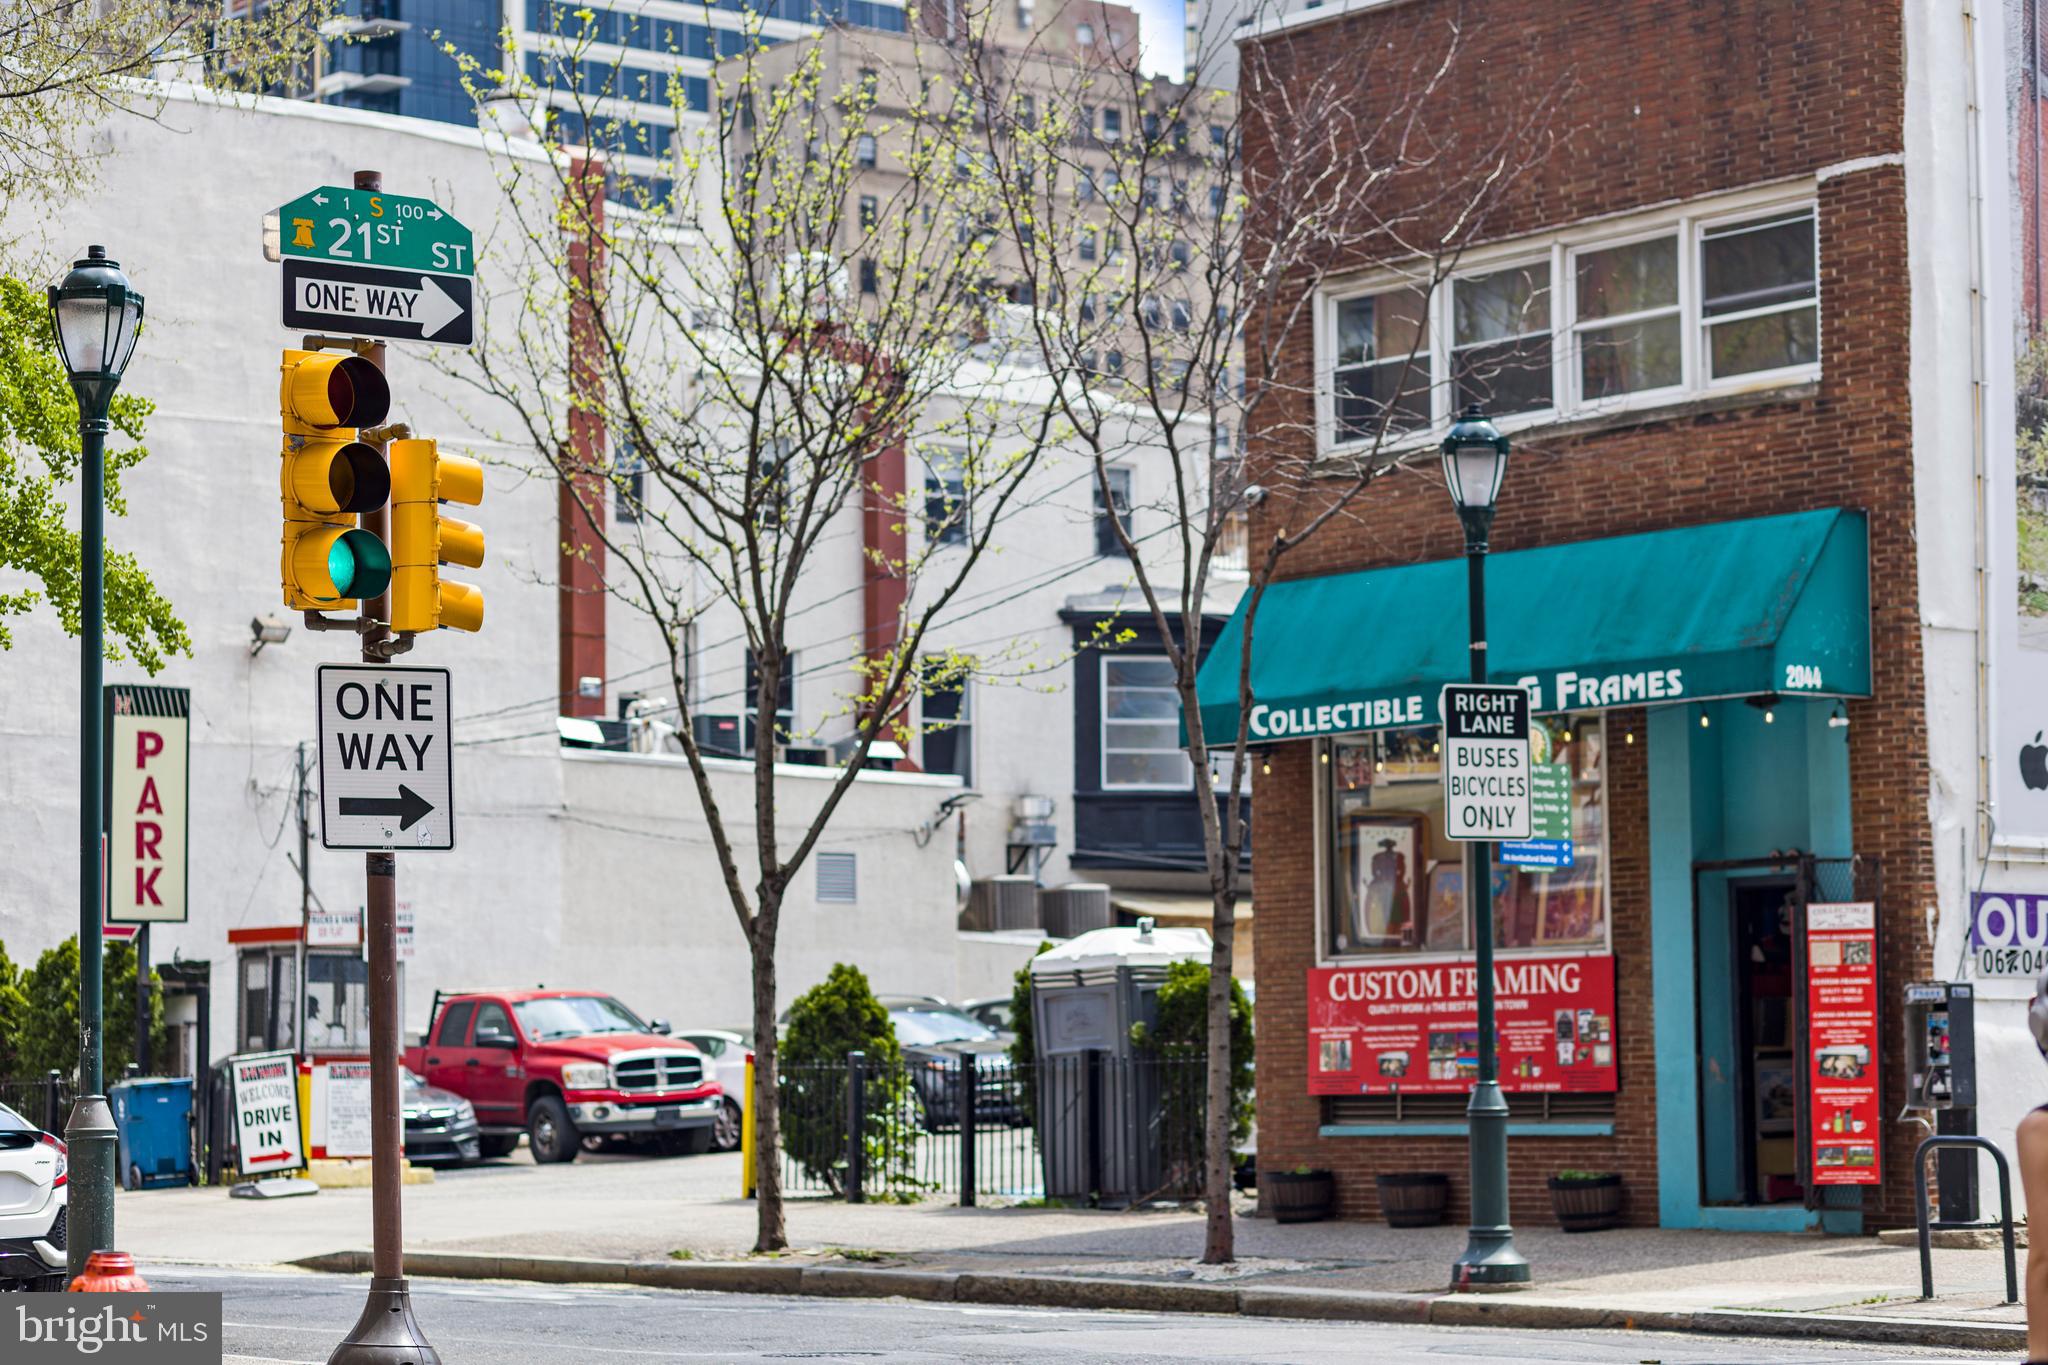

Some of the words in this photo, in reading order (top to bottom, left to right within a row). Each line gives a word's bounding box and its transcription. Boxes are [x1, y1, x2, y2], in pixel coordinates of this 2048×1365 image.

[344, 197, 350, 210] 1
[370, 197, 385, 217] S
[395, 204, 424, 220] 100
[328, 217, 404, 260] 21ST
[431, 242, 467, 270] ST
[305, 283, 356, 313] ONE
[366, 288, 418, 318] WAY
[1786, 664, 1822, 689] 2044
[336, 682, 434, 721] ONE
[1250, 695, 1423, 737] COLLECTIBLE
[1556, 668, 1684, 712] FRAMES
[1455, 693, 1519, 713] RIGHT
[1460, 715, 1515, 734] LANE
[337, 733, 434, 771] WAY
[1458, 747, 1519, 768] BUSES
[1452, 776, 1525, 797] BICYCLES
[136, 730, 164, 907] PARK
[1463, 805, 1516, 829] ONLY
[1328, 968, 1443, 1002] CUSTOM
[239, 1083, 291, 1105] WELCOME
[243, 1105, 292, 1127] DRIVE
[259, 1130, 282, 1147] IN
